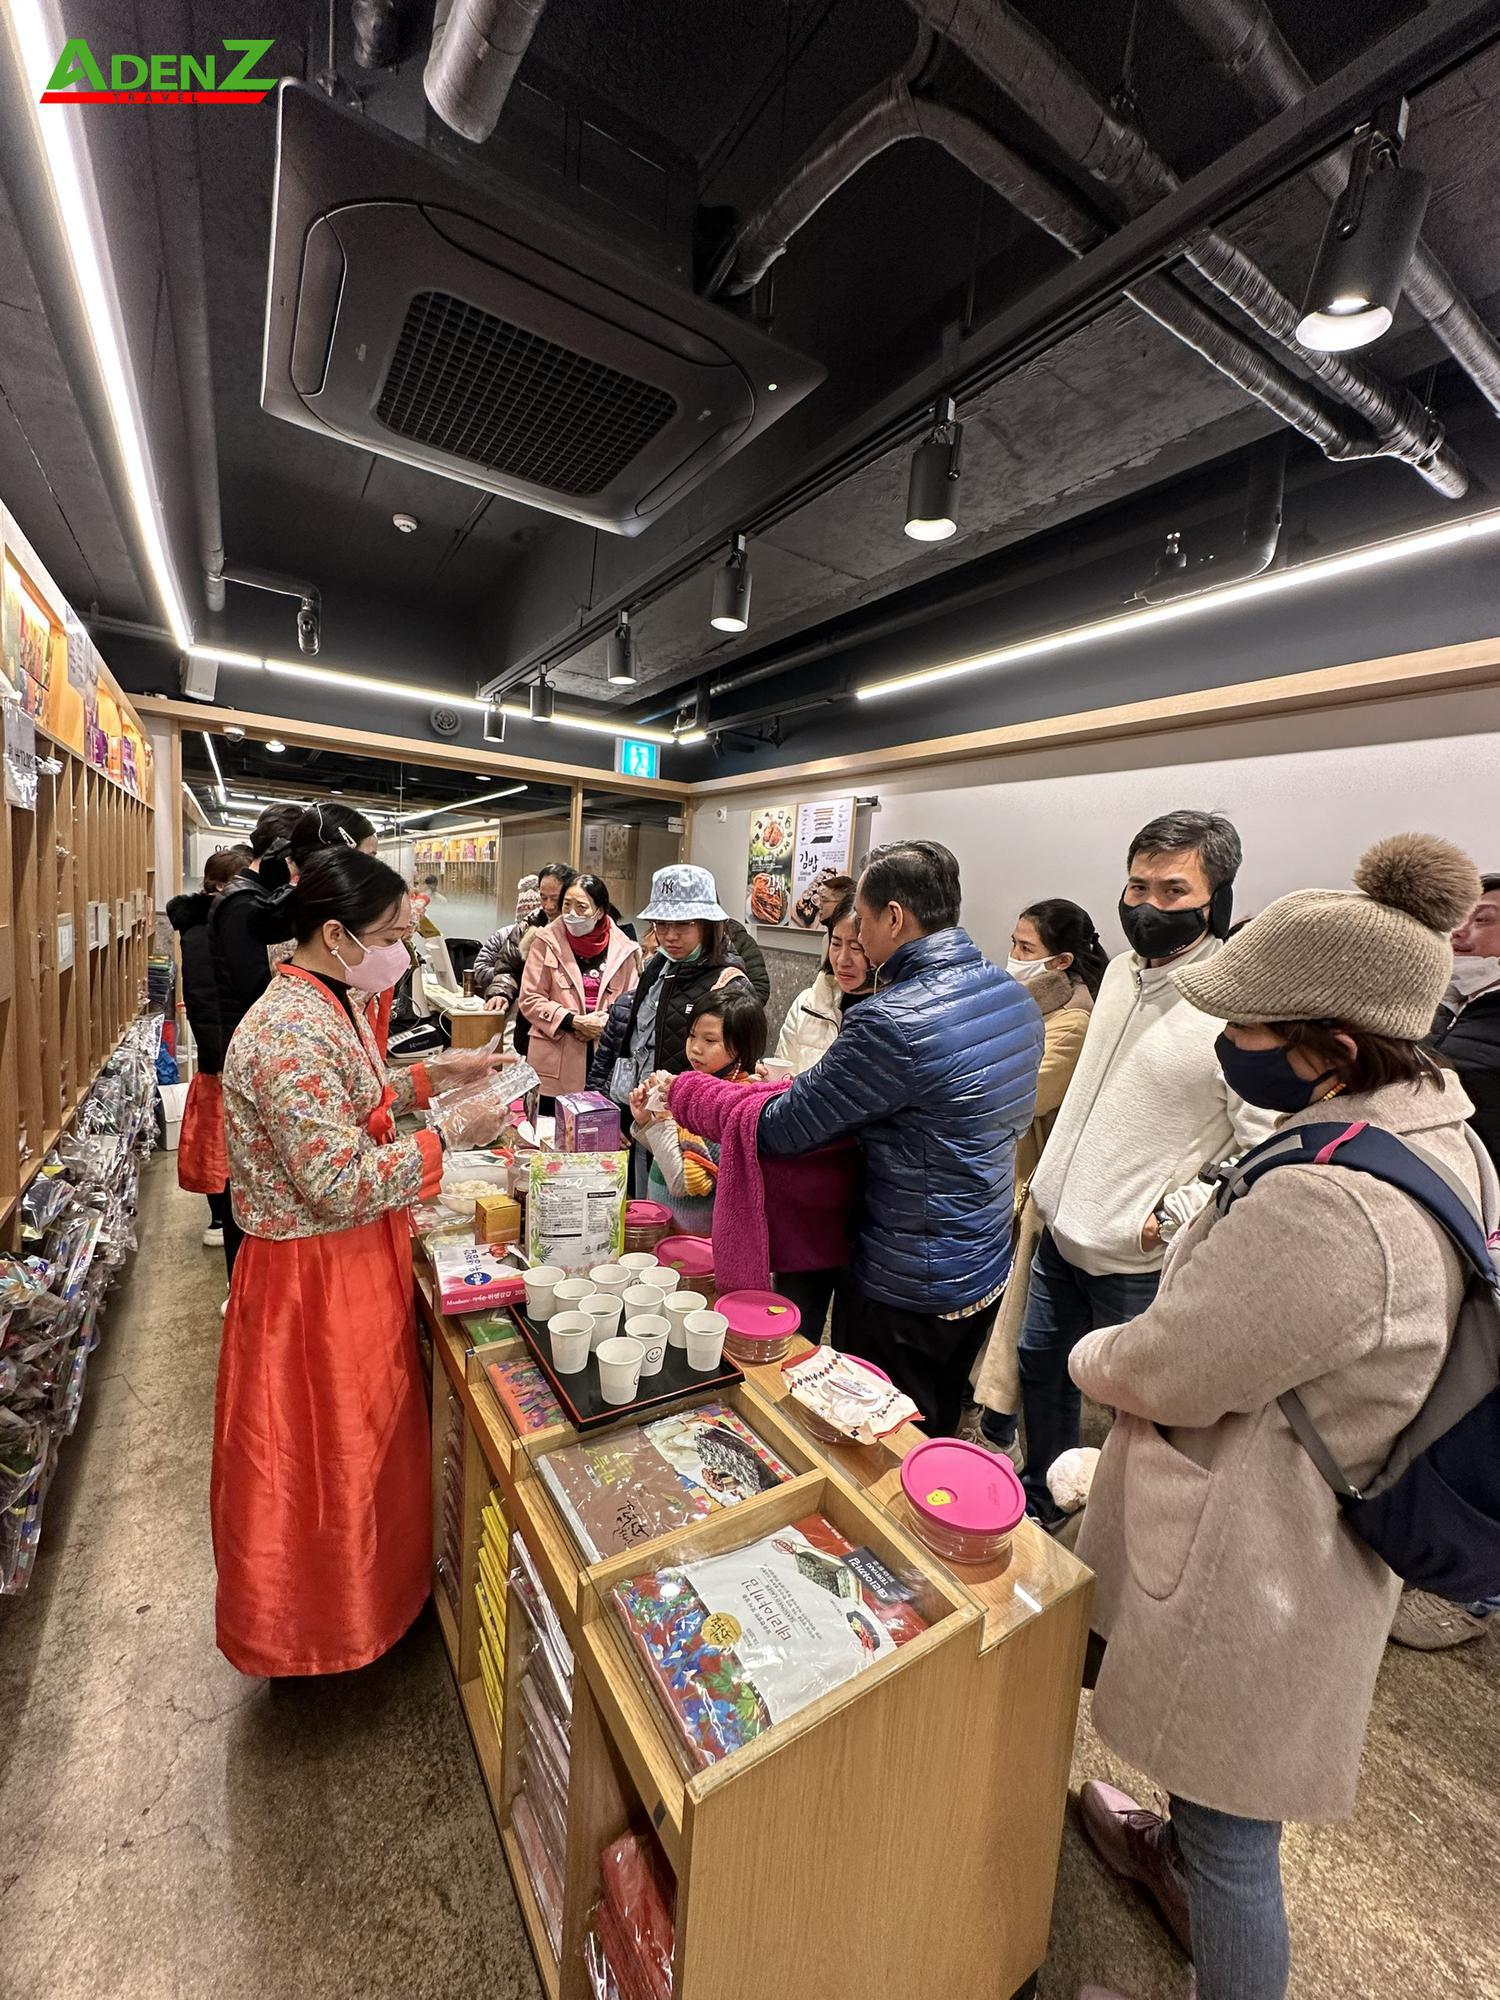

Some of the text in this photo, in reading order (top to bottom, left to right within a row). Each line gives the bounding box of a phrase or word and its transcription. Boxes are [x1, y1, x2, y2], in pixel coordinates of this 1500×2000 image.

[799, 850, 819, 873] 김밥
[661, 879, 674, 894] NY
[766, 874, 785, 896] 김치
[865, 1562, 889, 1584] TERIYAKI
[741, 1578, 792, 1641] 데리야끼김
